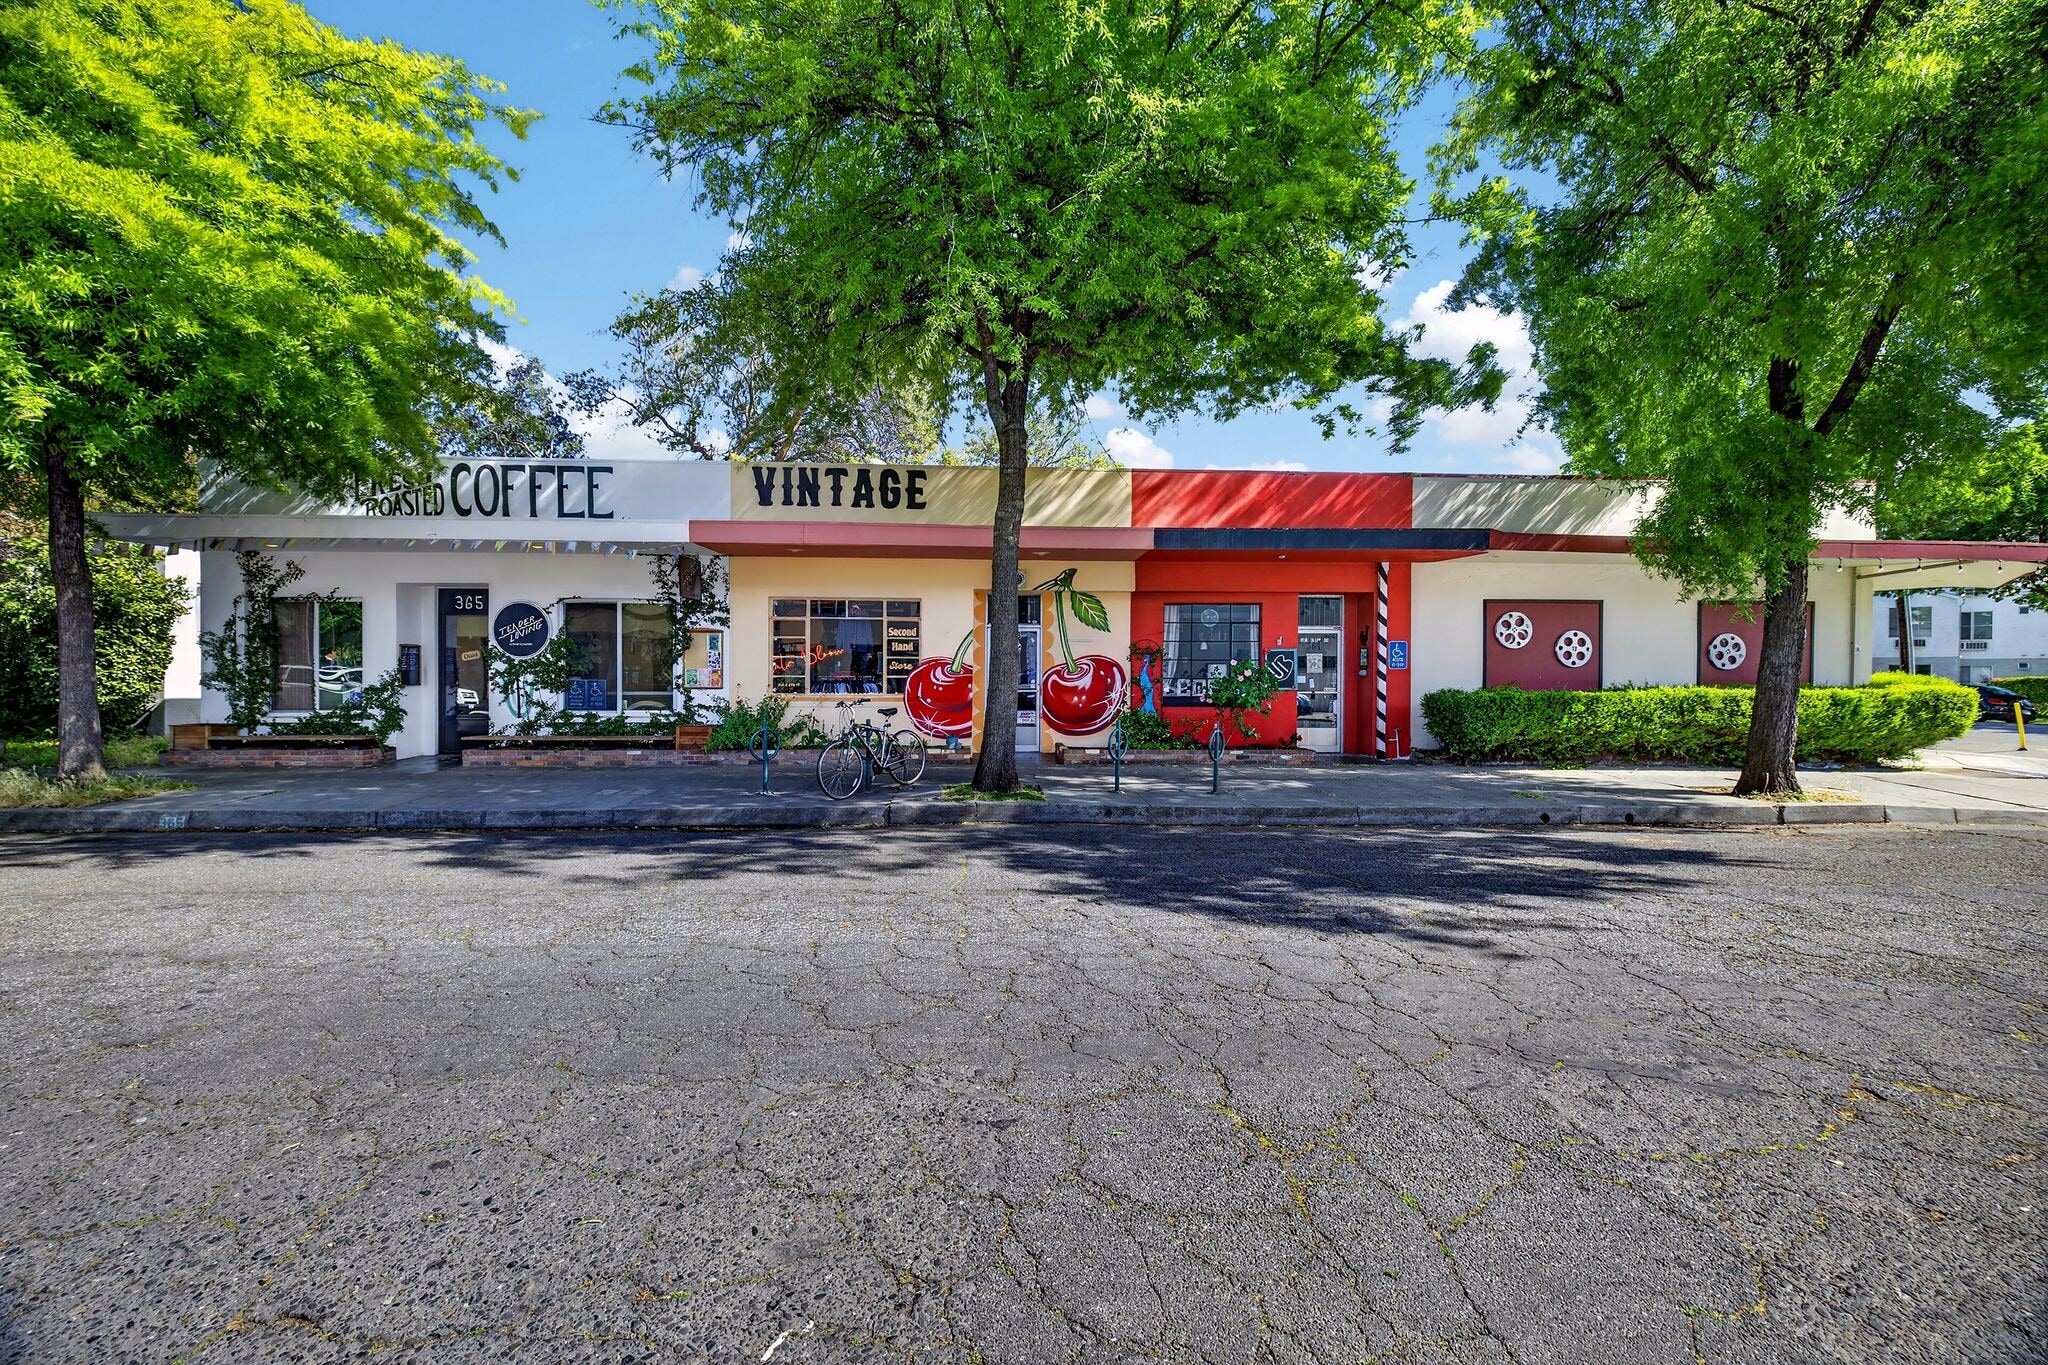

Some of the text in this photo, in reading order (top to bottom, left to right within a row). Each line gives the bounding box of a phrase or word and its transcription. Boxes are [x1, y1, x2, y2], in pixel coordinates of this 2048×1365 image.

[451, 462, 614, 518] COFFEE
[752, 466, 927, 509] VINTAGE
[360, 483, 445, 516] ROASTED
[455, 595, 484, 610] 365
[498, 615, 535, 636] TENDER
[510, 622, 543, 643] LOVING
[888, 627, 917, 637] Second
[891, 642, 914, 651] Hand
[889, 661, 914, 670] Store
